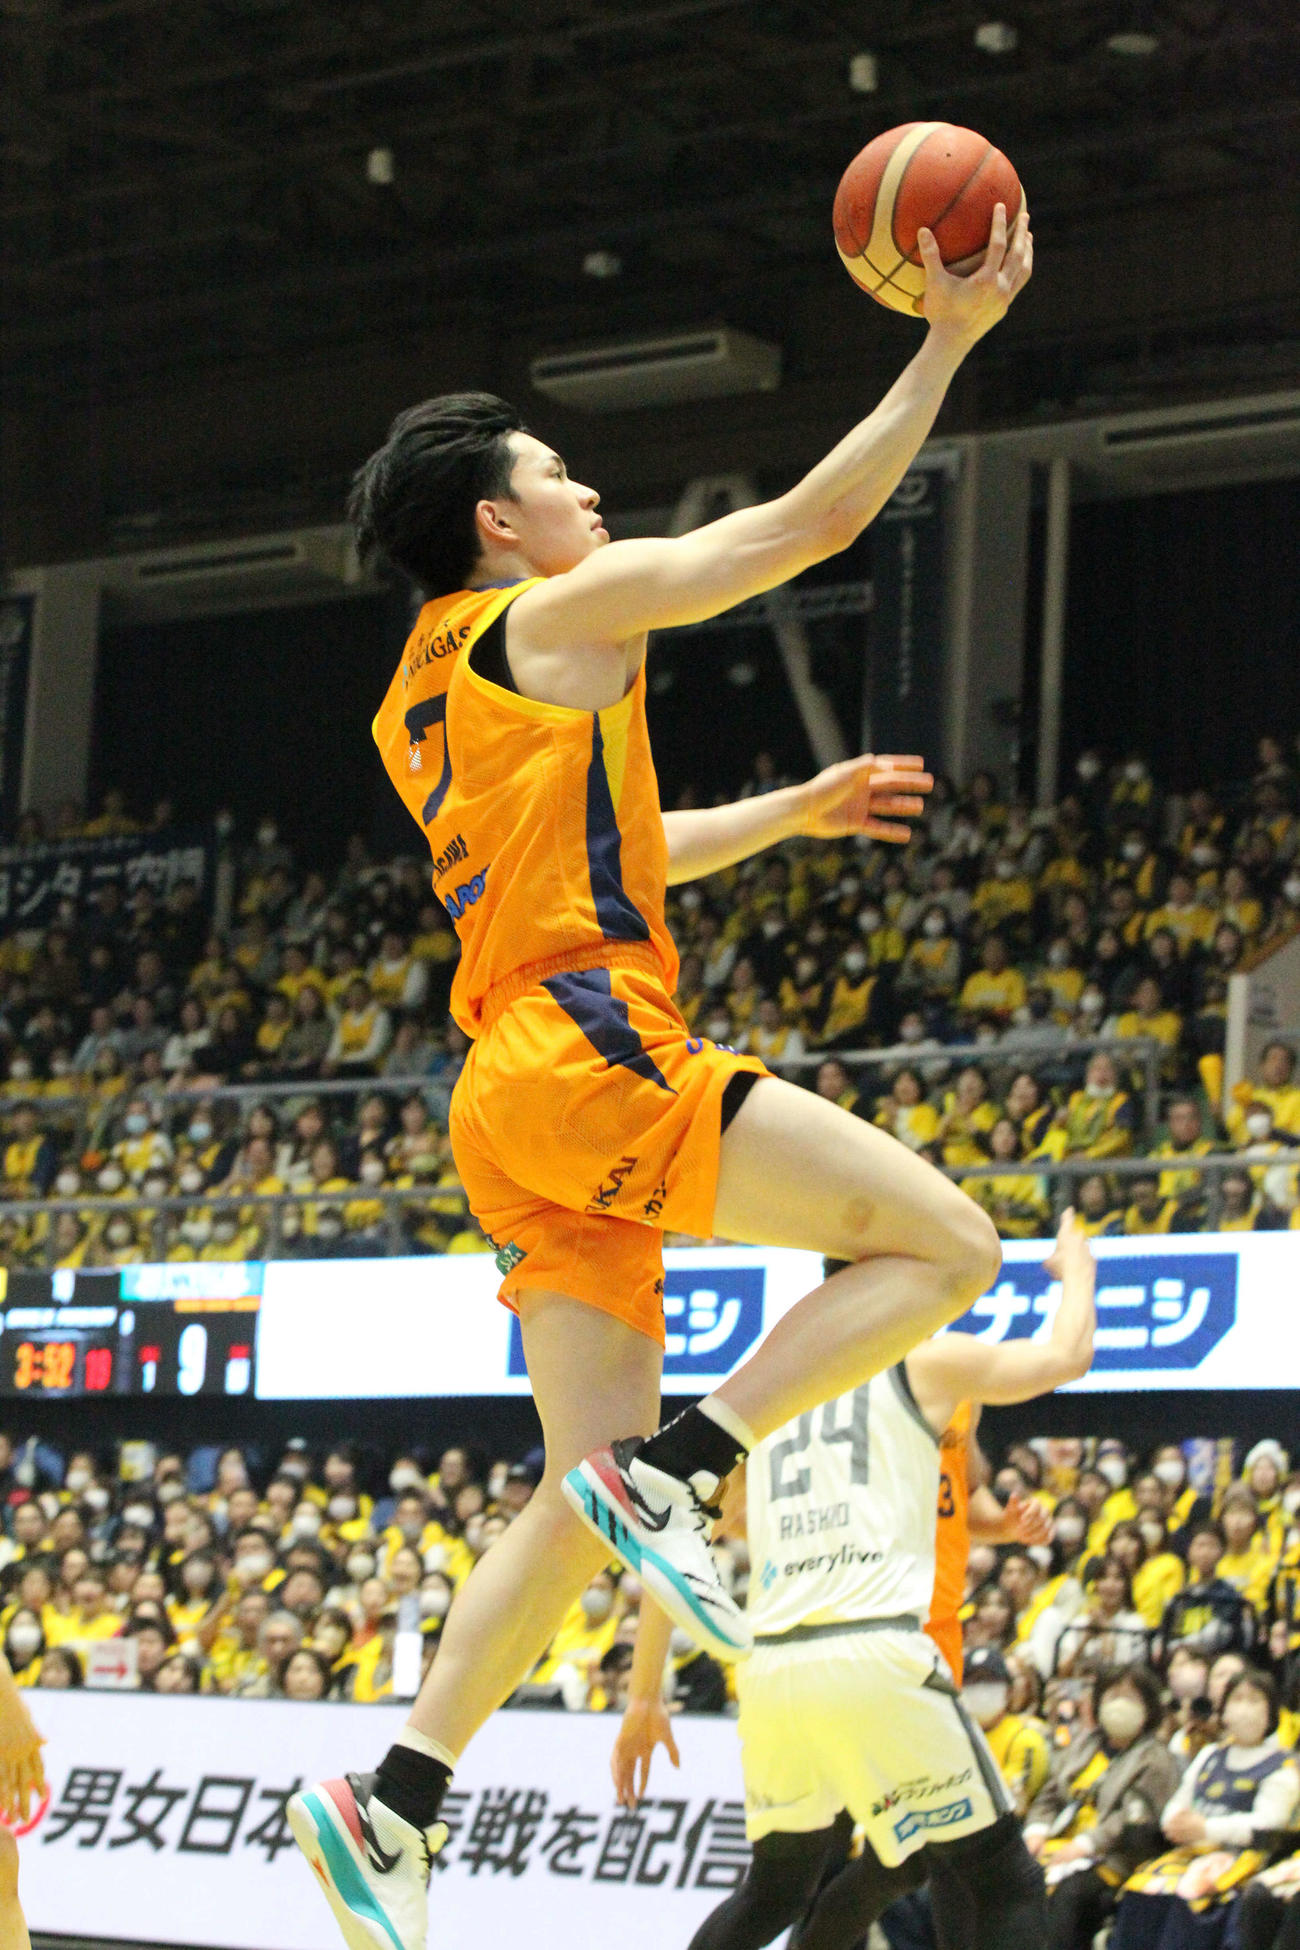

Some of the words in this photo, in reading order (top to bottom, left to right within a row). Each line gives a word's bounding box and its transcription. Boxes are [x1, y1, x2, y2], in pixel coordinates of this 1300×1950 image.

[404, 691, 453, 826] 7
[769, 1382, 870, 1502] 24
[784, 1543, 883, 1577] everylive
